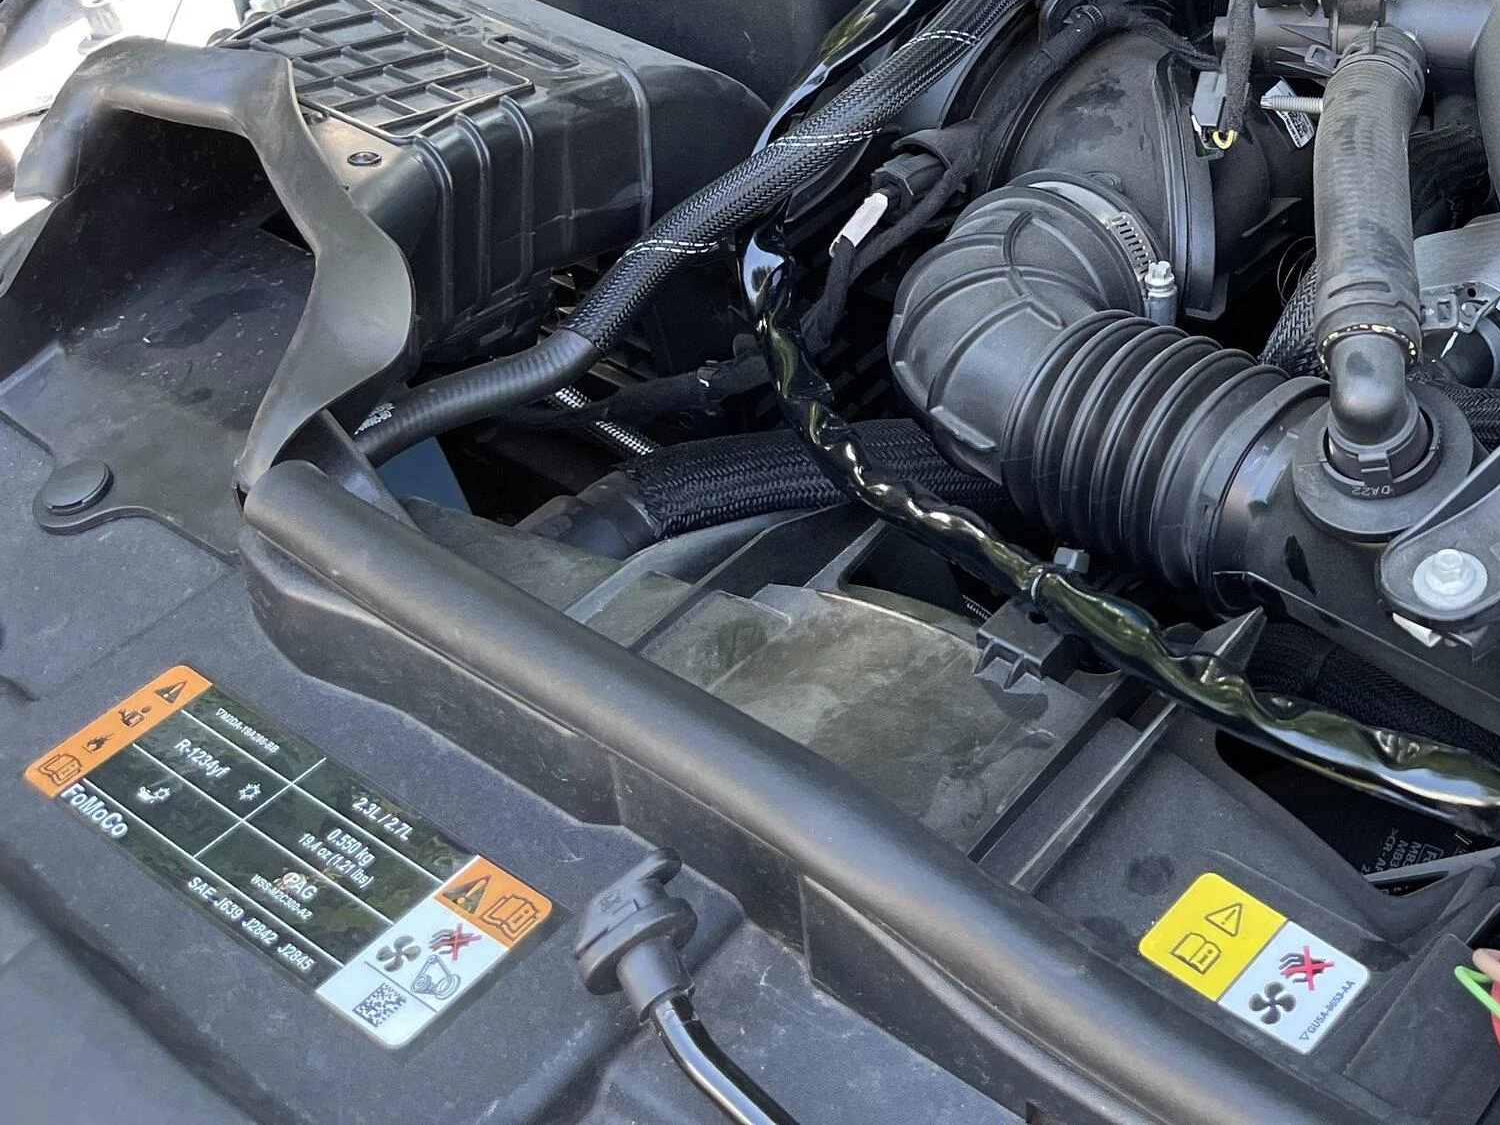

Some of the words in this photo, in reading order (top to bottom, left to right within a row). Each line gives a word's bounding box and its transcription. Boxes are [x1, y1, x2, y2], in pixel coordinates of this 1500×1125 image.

[174, 738, 231, 778] R-1234yf
[60, 783, 129, 838] FoMoCo
[352, 797, 381, 820] 2.3L
[383, 817, 413, 842] 2.7L
[316, 846, 333, 860] oz
[350, 865, 375, 889] lbs)
[326, 828, 363, 856] 0.550
[355, 846, 376, 868] kg
[286, 874, 318, 901] PAG
[187, 876, 218, 900] SAE
[213, 897, 244, 920] J639
[241, 917, 279, 945] J2842
[277, 943, 316, 971] J2845
